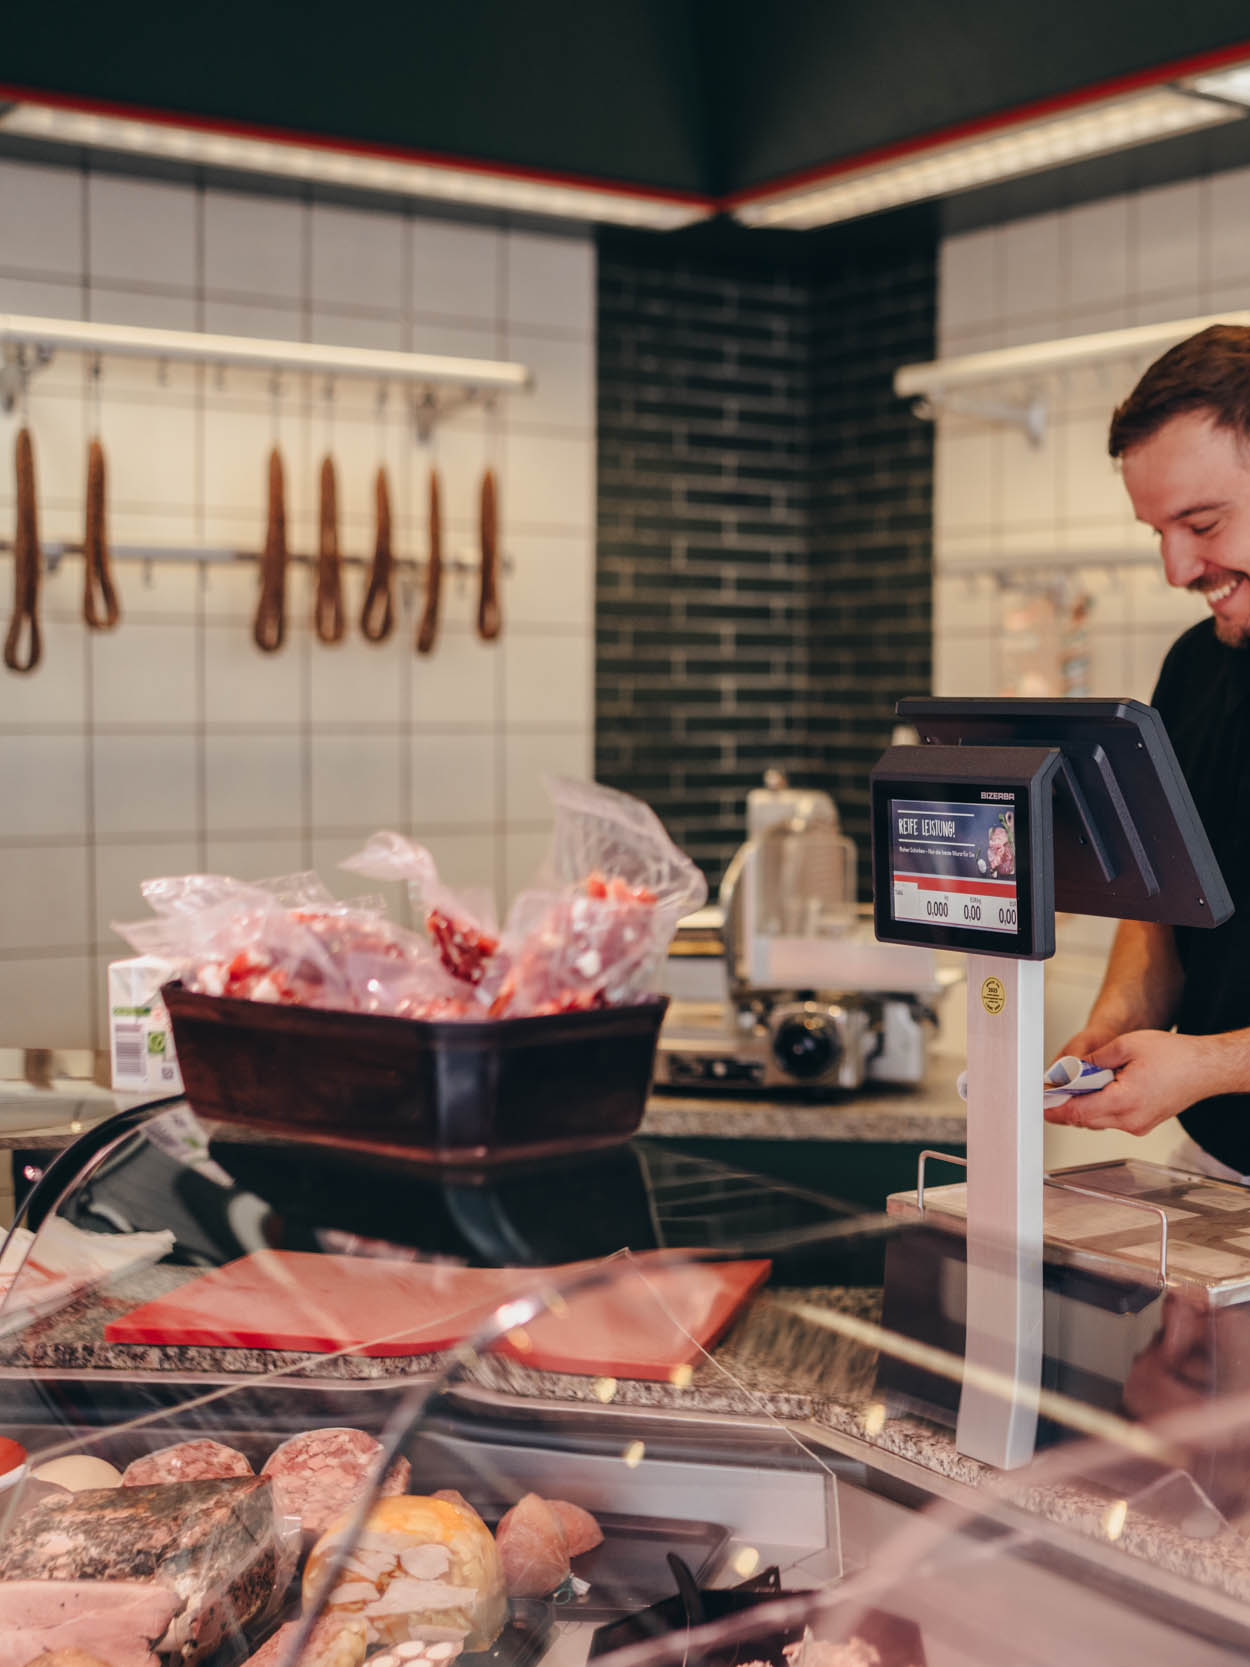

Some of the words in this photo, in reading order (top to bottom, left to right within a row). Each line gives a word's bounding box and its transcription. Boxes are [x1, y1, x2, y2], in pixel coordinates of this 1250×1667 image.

[981, 792, 1015, 801] BIZERBA
[899, 818, 918, 835] REIFE
[922, 819, 956, 838] LEISTUNG!
[964, 905, 981, 921] 0,00
[999, 908, 1017, 925] 0,00
